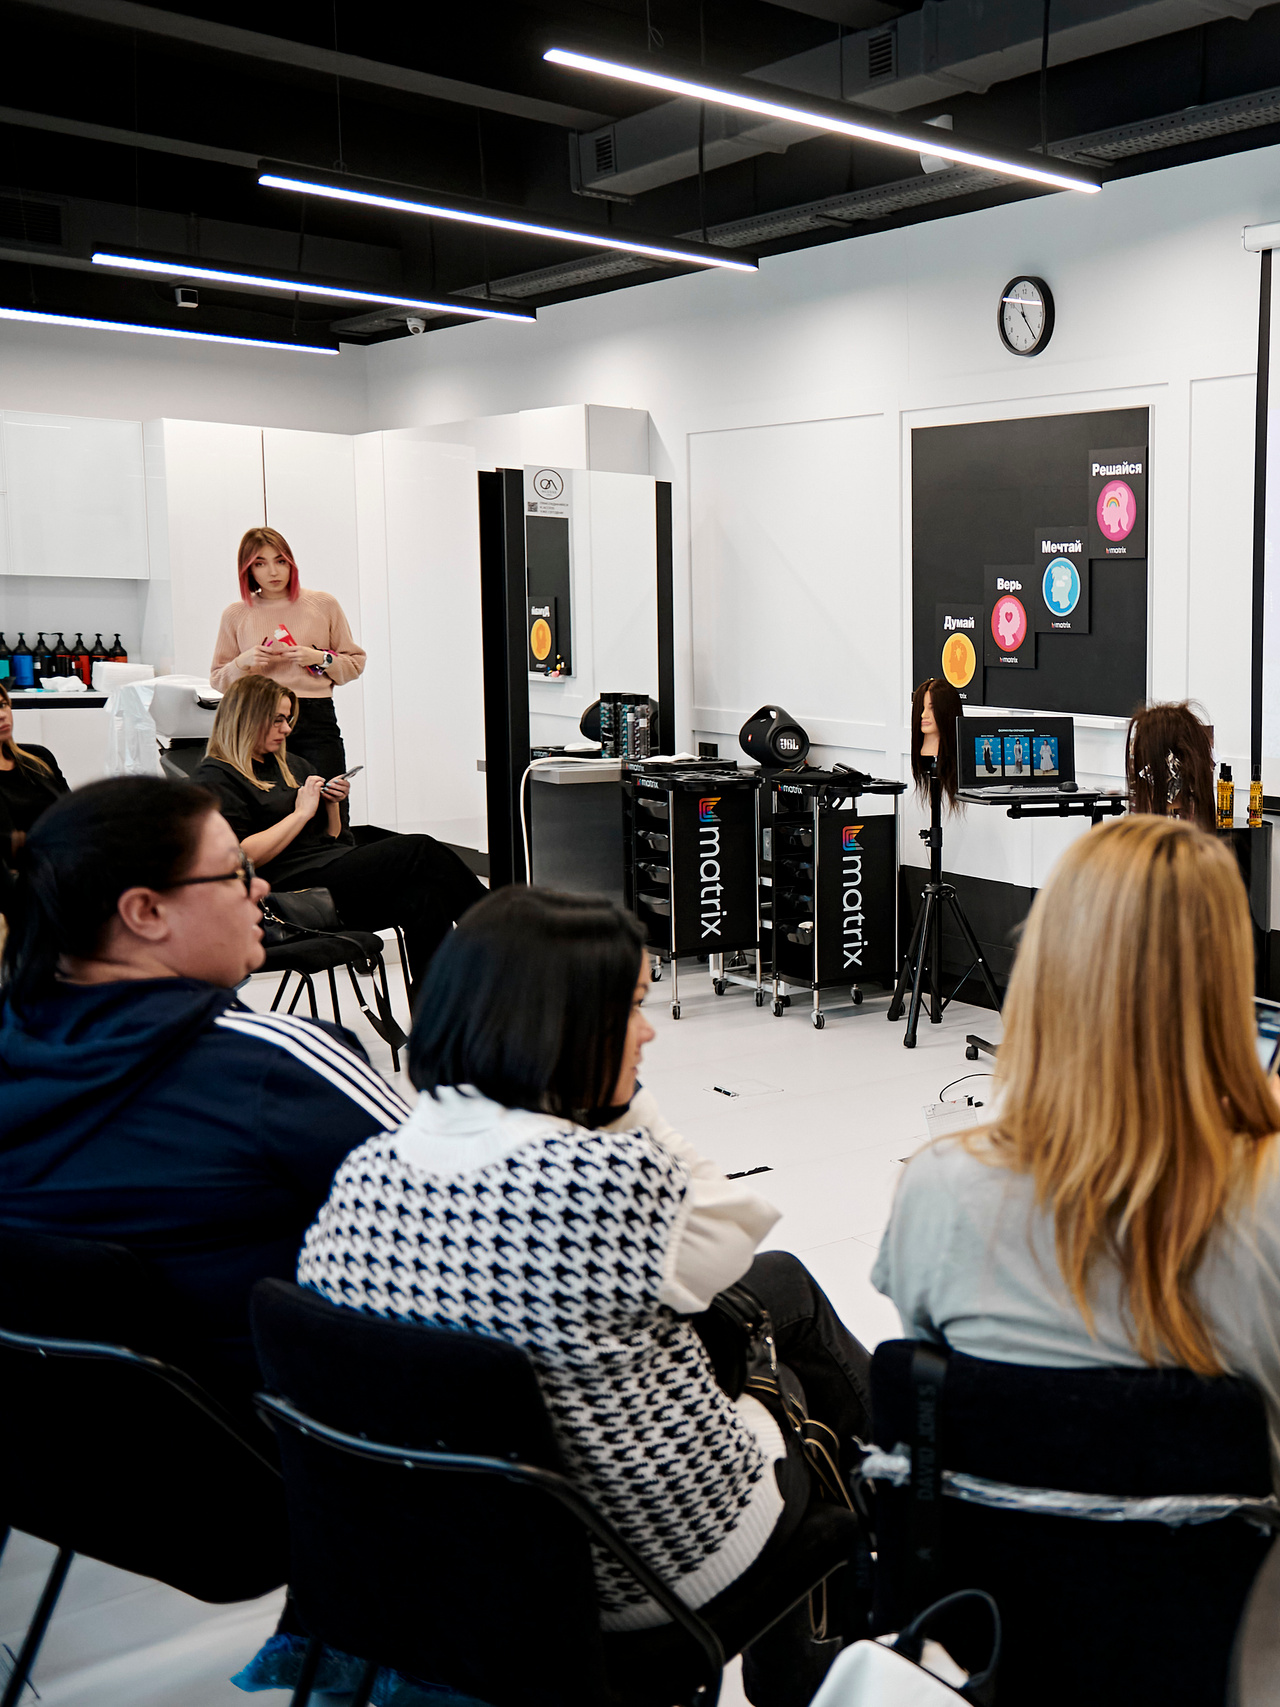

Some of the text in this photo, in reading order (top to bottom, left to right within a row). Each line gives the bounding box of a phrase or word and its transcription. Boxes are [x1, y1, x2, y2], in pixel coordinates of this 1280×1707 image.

[1092, 461, 1142, 477] Решайся
[1041, 540, 1082, 554] Мечтай
[996, 577, 1022, 592] Верь
[943, 615, 975, 630] Думай
[780, 738, 799, 750] JBL
[699, 826, 727, 938] matrix
[842, 855, 868, 969] matrix
